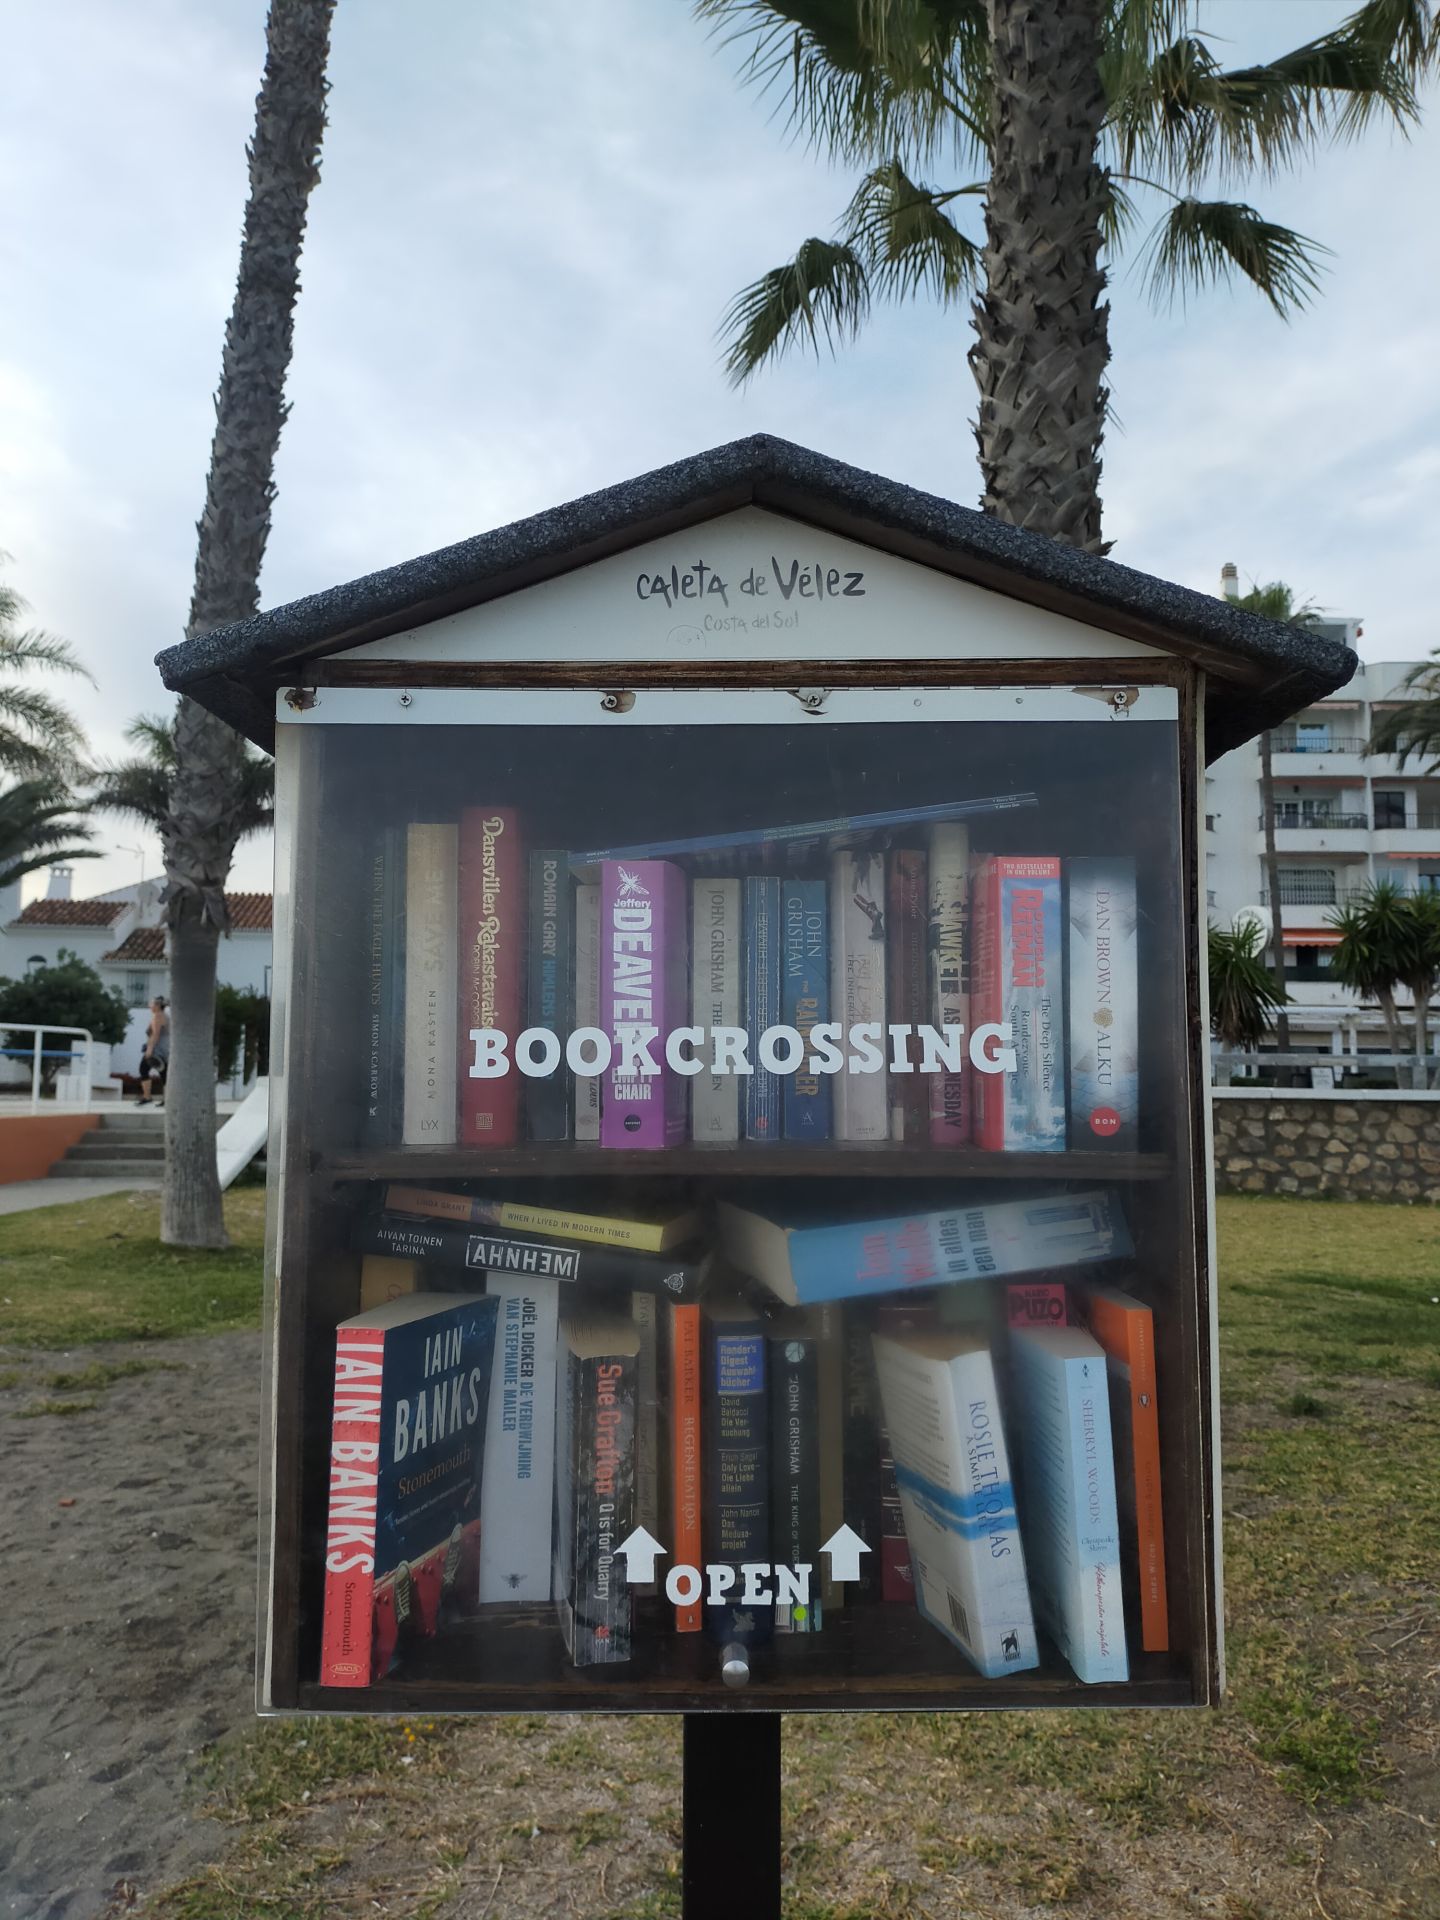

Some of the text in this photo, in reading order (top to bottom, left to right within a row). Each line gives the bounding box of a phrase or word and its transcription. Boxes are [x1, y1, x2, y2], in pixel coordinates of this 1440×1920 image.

[739, 567, 768, 597] de
[771, 555, 866, 601] Vélez
[703, 609, 800, 633] Costa del Sol
[482, 816, 505, 916] Dansvillen
[543, 860, 557, 917] ROMAIN
[613, 899, 651, 910] Jeffery
[708, 889, 725, 927] JOHN
[542, 918, 557, 957] GARY
[787, 897, 803, 977] GRISHAM
[805, 910, 822, 957] JOHN
[940, 908, 962, 974] HAWKE
[1011, 889, 1044, 987] REEMAN
[370, 855, 384, 1099] WHEN THE EAGLE HUNTS SIMON SCARROW
[472, 944, 480, 974] ROBIN
[710, 929, 725, 993] GRISHAM
[542, 960, 556, 1016] HIMLENS
[1096, 890, 1112, 1086] DAN BROWN ALKU
[712, 1003, 722, 1026] THE
[427, 990, 437, 1099] NONA KASTEN
[468, 1022, 1018, 1079] BOOKCROSSING
[1040, 997, 1053, 1092] The Deep Silence
[943, 1007, 962, 1128] AS NESDAY
[614, 1084, 652, 1100] CHAIR
[421, 1119, 439, 1131] LYX
[441, 1202, 465, 1211] GRANT
[507, 1212, 529, 1223] WHEN
[537, 1217, 558, 1227] LIVED
[561, 1221, 569, 1229] IN
[572, 1223, 605, 1235] MODERN
[607, 1228, 631, 1239] TIMES
[377, 1229, 443, 1247] AIVAN TOINEN
[391, 1242, 426, 1256] TARINA
[938, 1218, 964, 1255] alles
[965, 1211, 997, 1273] een man
[639, 1297, 649, 1328] DYAN
[1008, 1292, 1064, 1321] PUZO
[424, 1325, 463, 1379] IAIN
[502, 1298, 521, 1432] VAN STEPHANIE MAILER
[720, 1344, 757, 1354] Reader's
[720, 1355, 749, 1367] Digest
[517, 1297, 539, 1479] JOËL DICKER DE VERDWIJNING
[720, 1376, 751, 1387] bücher
[788, 1375, 800, 1412] JOHN
[394, 1367, 481, 1464] BANKS
[721, 1397, 740, 1406] David
[721, 1407, 749, 1416] Baldacci
[595, 1364, 623, 1495] Sue Grafton
[684, 1320, 696, 1530] PAT BARKER REGENERATION
[721, 1417, 734, 1426] Die
[721, 1428, 751, 1438] suchung
[326, 1343, 385, 1573] IAIN BANKS
[789, 1417, 800, 1475] GRISHAM
[1082, 1399, 1101, 1524] SHERRYL WOODS
[398, 1443, 471, 1499] Stonemouth
[721, 1463, 737, 1473] Only
[721, 1474, 734, 1482] Die
[969, 1400, 1011, 1559] ROSIE THOMAS
[721, 1484, 742, 1493] allein
[790, 1485, 799, 1502] THE
[968, 1448, 984, 1498] SIMPLE
[976, 1501, 987, 1530] LIFE
[598, 1517, 614, 1529] is
[721, 1508, 738, 1518] John
[721, 1520, 735, 1528] Das
[791, 1505, 799, 1527] KING
[598, 1532, 615, 1551] for
[721, 1540, 747, 1551] projekt
[593, 1556, 615, 1600] Quarry
[665, 1563, 813, 1607] OPEN
[342, 1582, 356, 1656] Stonemouth
